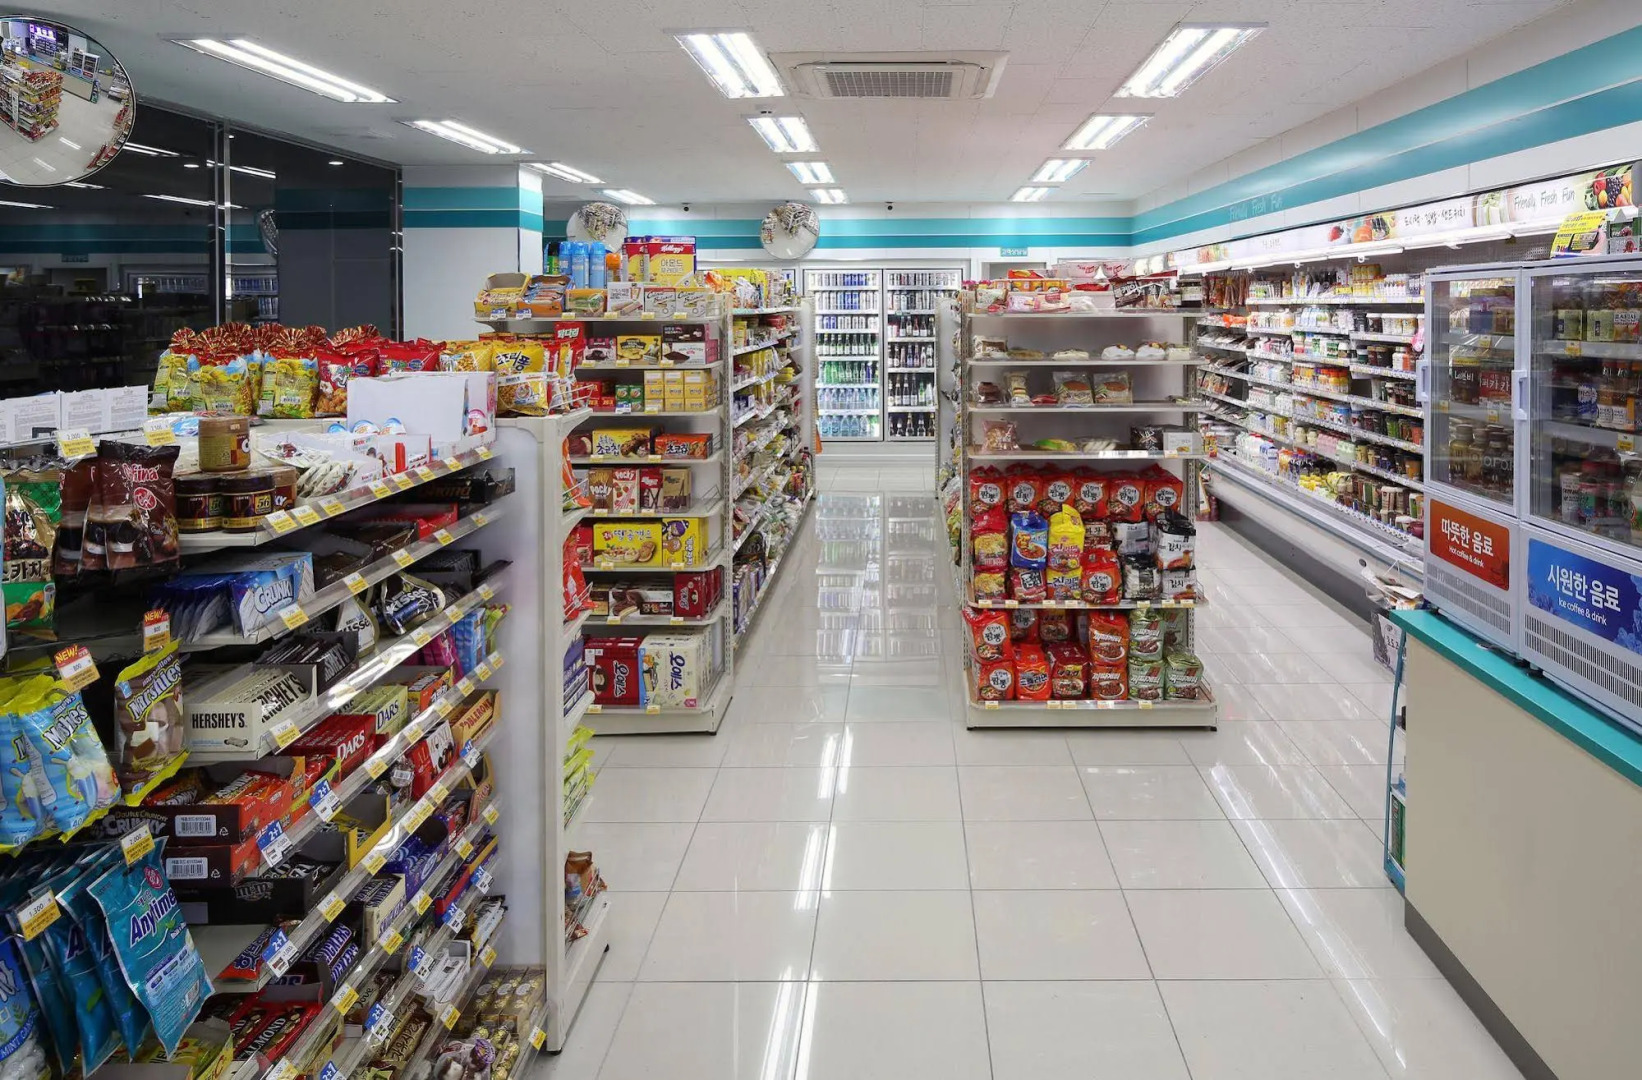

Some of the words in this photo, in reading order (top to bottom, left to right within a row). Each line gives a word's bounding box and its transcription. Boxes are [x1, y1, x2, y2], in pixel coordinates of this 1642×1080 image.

[1514, 194, 1536, 213] Friendly
[1541, 190, 1558, 207] Fresh
[1562, 186, 1576, 202] Fun
[1441, 517, 1470, 548] 따뜻한
[1472, 531, 1494, 557] 음료
[1449, 545, 1457, 555] Hot
[1457, 550, 1469, 562] coffee
[1473, 556, 1484, 568] drink
[1547, 564, 1588, 602] 시원한
[1590, 580, 1621, 612] 음료
[144, 609, 163, 622] NEW!
[1558, 596, 1566, 609] Ice
[1567, 601, 1585, 617] coffee
[1585, 608, 1591, 618] &
[1591, 611, 1607, 626] drink
[55, 645, 78, 663] NEW!
[192, 712, 246, 729] HERSHEY'S
[377, 699, 399, 730] DARS
[337, 729, 365, 761] DARS
[318, 780, 331, 797] 2+1
[269, 823, 283, 841] 2+1
[130, 887, 178, 949] Anytime
[272, 930, 287, 952] 2+1
[372, 1003, 384, 1020] 2+1
[0, 1036, 21, 1059] MINT
